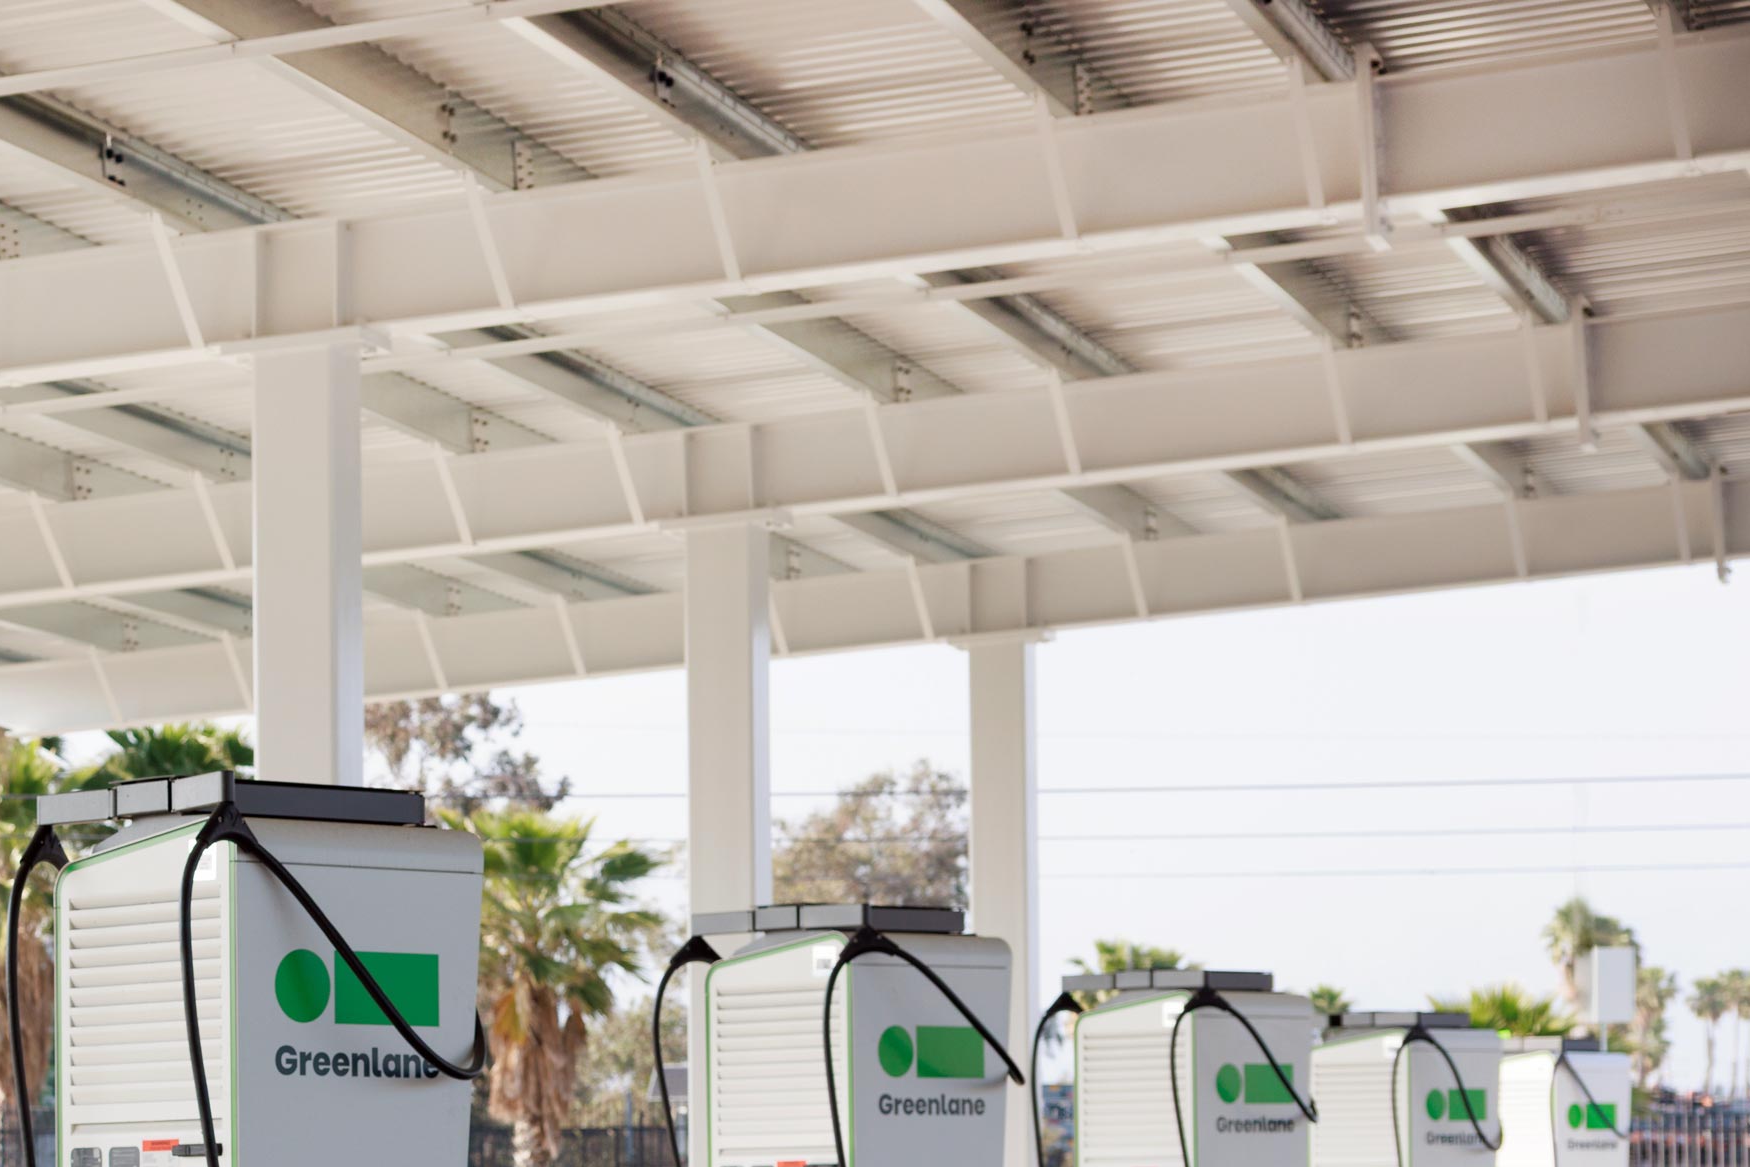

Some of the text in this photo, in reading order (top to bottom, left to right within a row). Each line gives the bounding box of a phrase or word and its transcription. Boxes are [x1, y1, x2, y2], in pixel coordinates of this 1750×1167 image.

[275, 1044, 440, 1079] Greenlane
[878, 1093, 986, 1116] Greenlane
[1216, 1115, 1295, 1133] Greenlane
[1426, 1131, 1483, 1146] Greenlan
